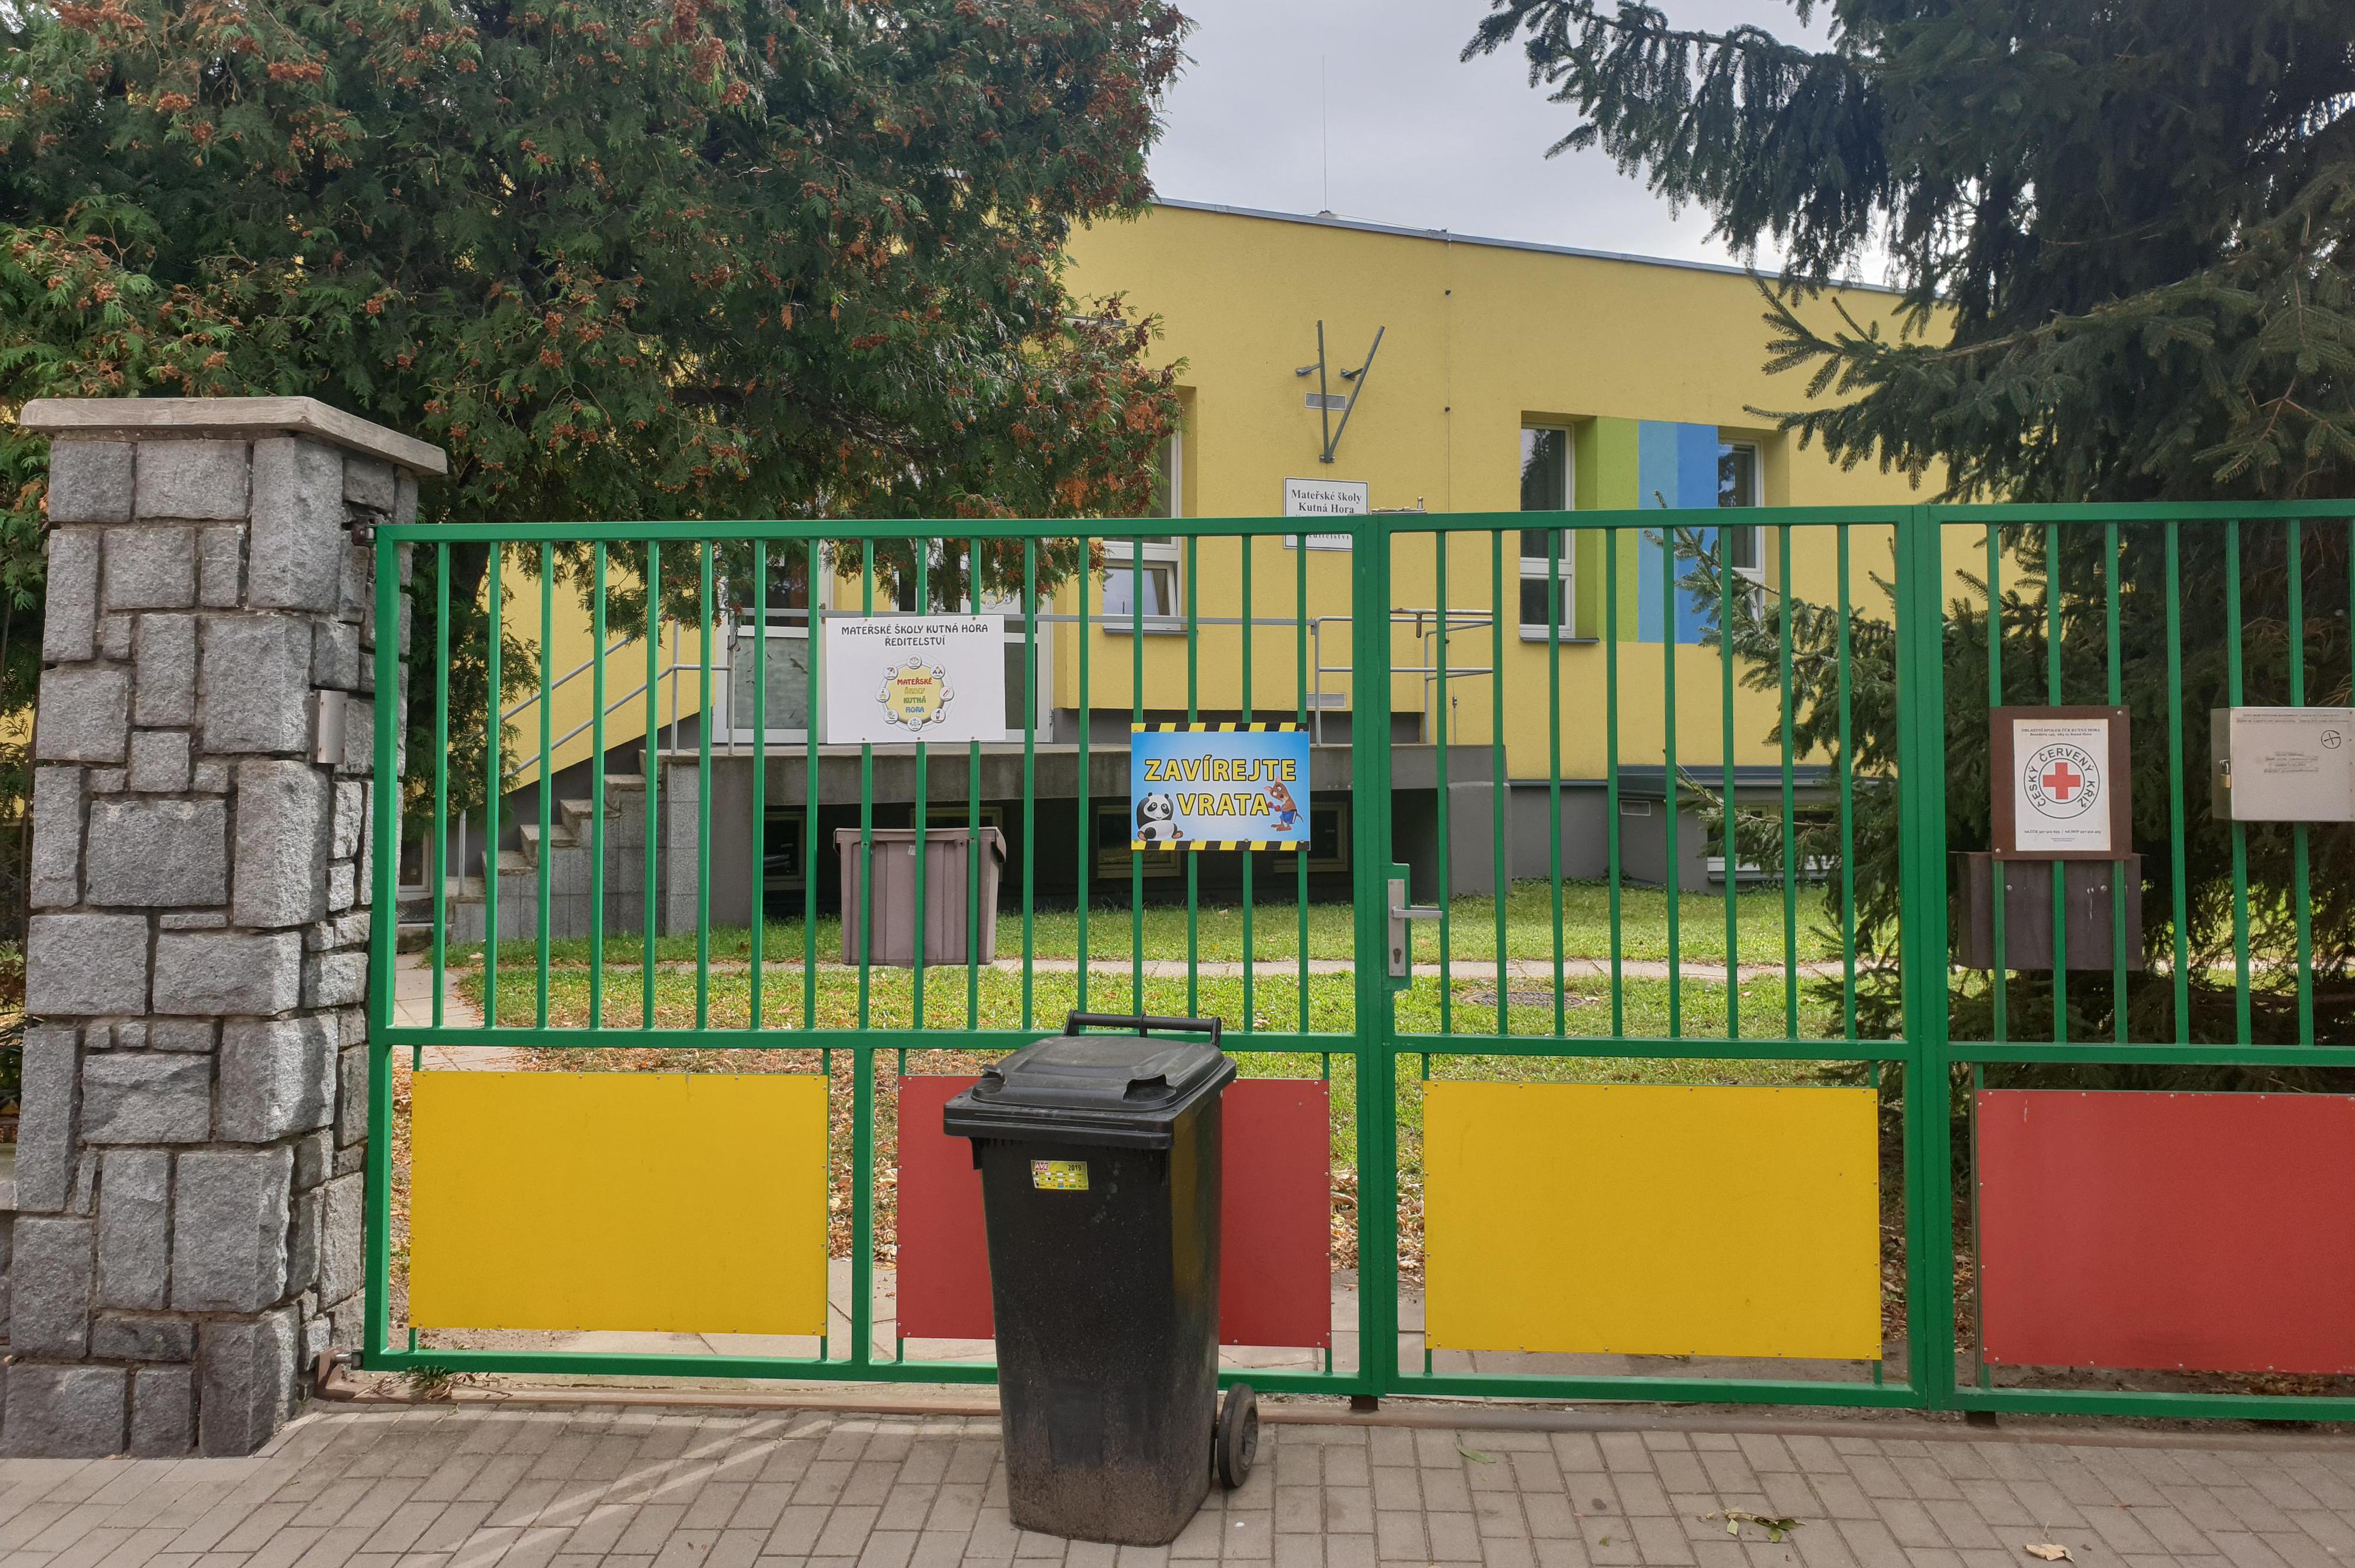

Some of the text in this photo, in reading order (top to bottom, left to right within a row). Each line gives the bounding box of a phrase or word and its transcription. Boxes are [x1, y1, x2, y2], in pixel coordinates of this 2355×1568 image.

[1291, 489, 1362, 504] Mateřské školy
[1299, 502, 1354, 513] Kutná Hora
[841, 623, 989, 635] MATEŘSKÉ ŠKOLY KUTNÁ HORA
[885, 635, 946, 646] ŘEDITELSTVÍ
[903, 696, 926, 704] KUTNÁ
[1144, 754, 1296, 782] ZAVÍREJTE
[2028, 748, 2095, 808] ČESKÝ ČERVENÝ KŘÍŽ
[1176, 793, 1270, 816] VRATA
